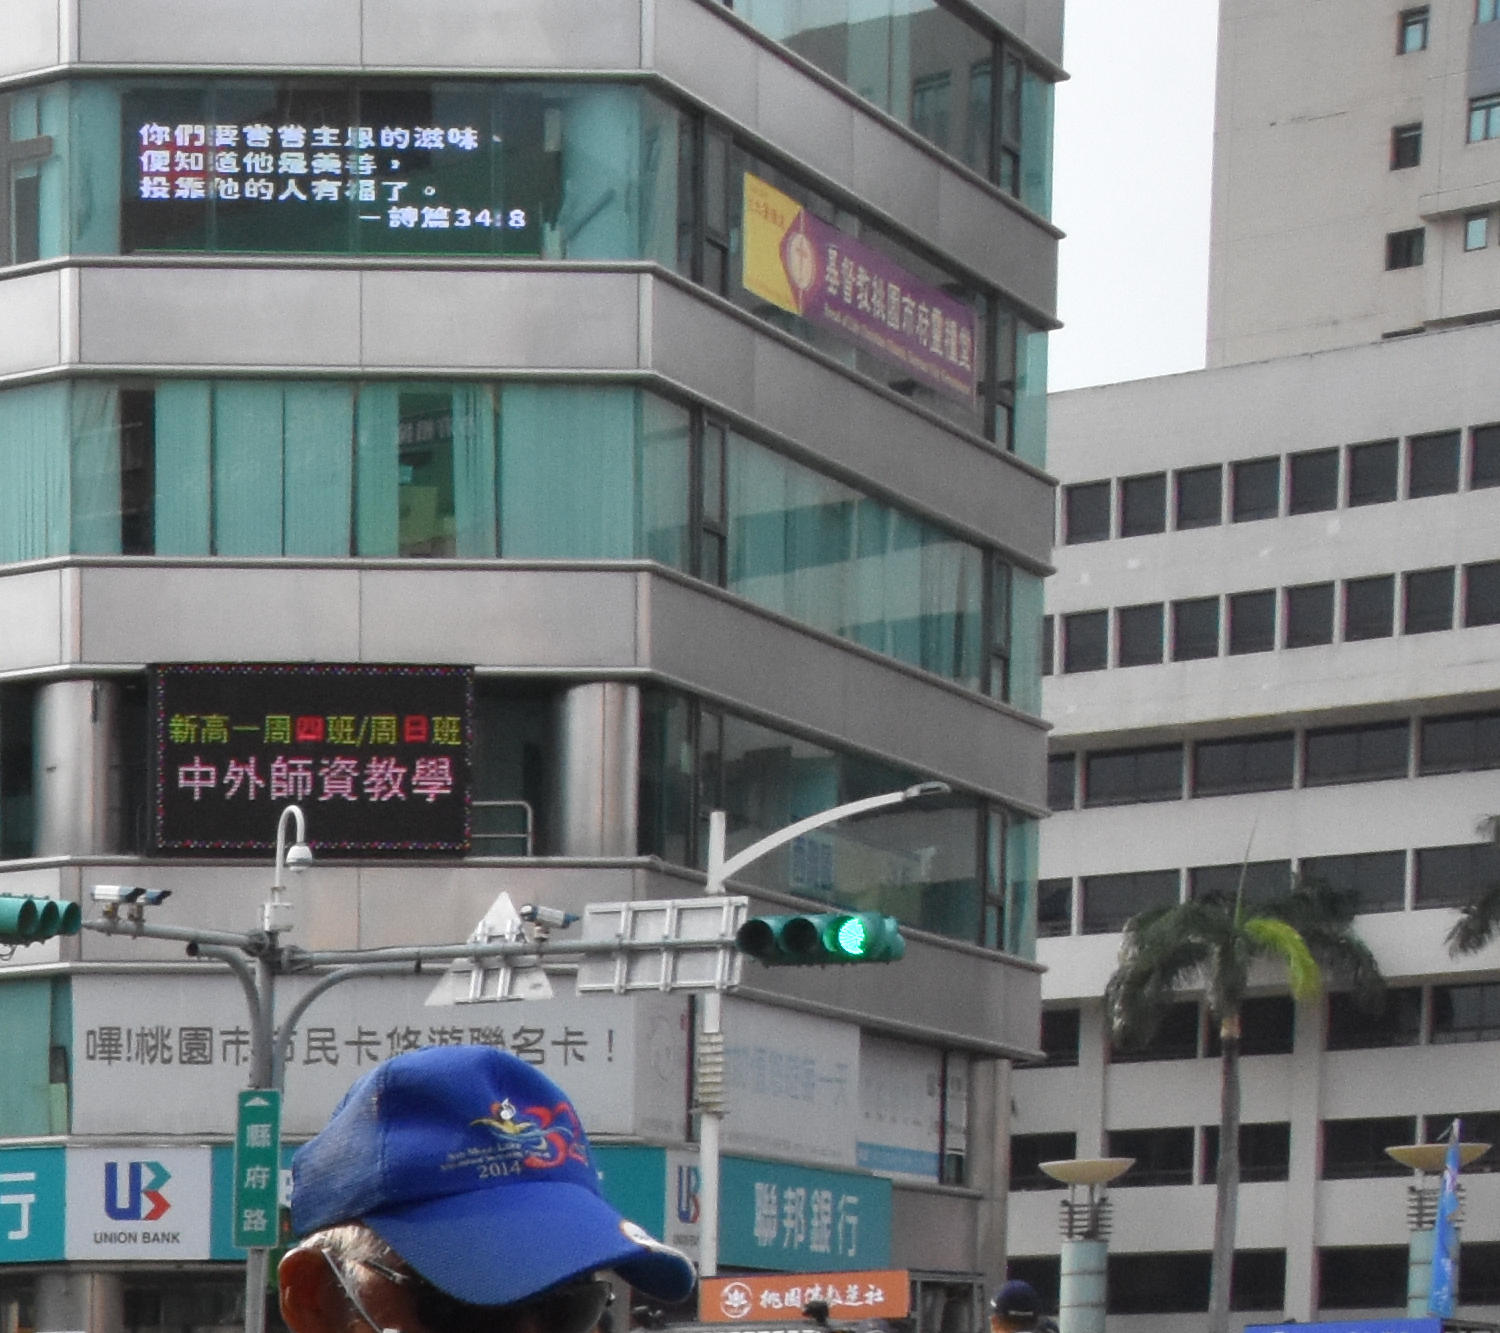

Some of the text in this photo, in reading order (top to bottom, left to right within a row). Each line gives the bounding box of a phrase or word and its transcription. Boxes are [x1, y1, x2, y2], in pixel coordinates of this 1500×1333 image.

[168, 712, 462, 747] 新高一周四班/周日班
[176, 754, 454, 803] 中外師資教學
[243, 1123, 272, 1234] 縣府路
[478, 1160, 522, 1179] 2014
[92, 1230, 181, 1245] UNION BANK
[753, 1181, 860, 1258] 聯邦銀行
